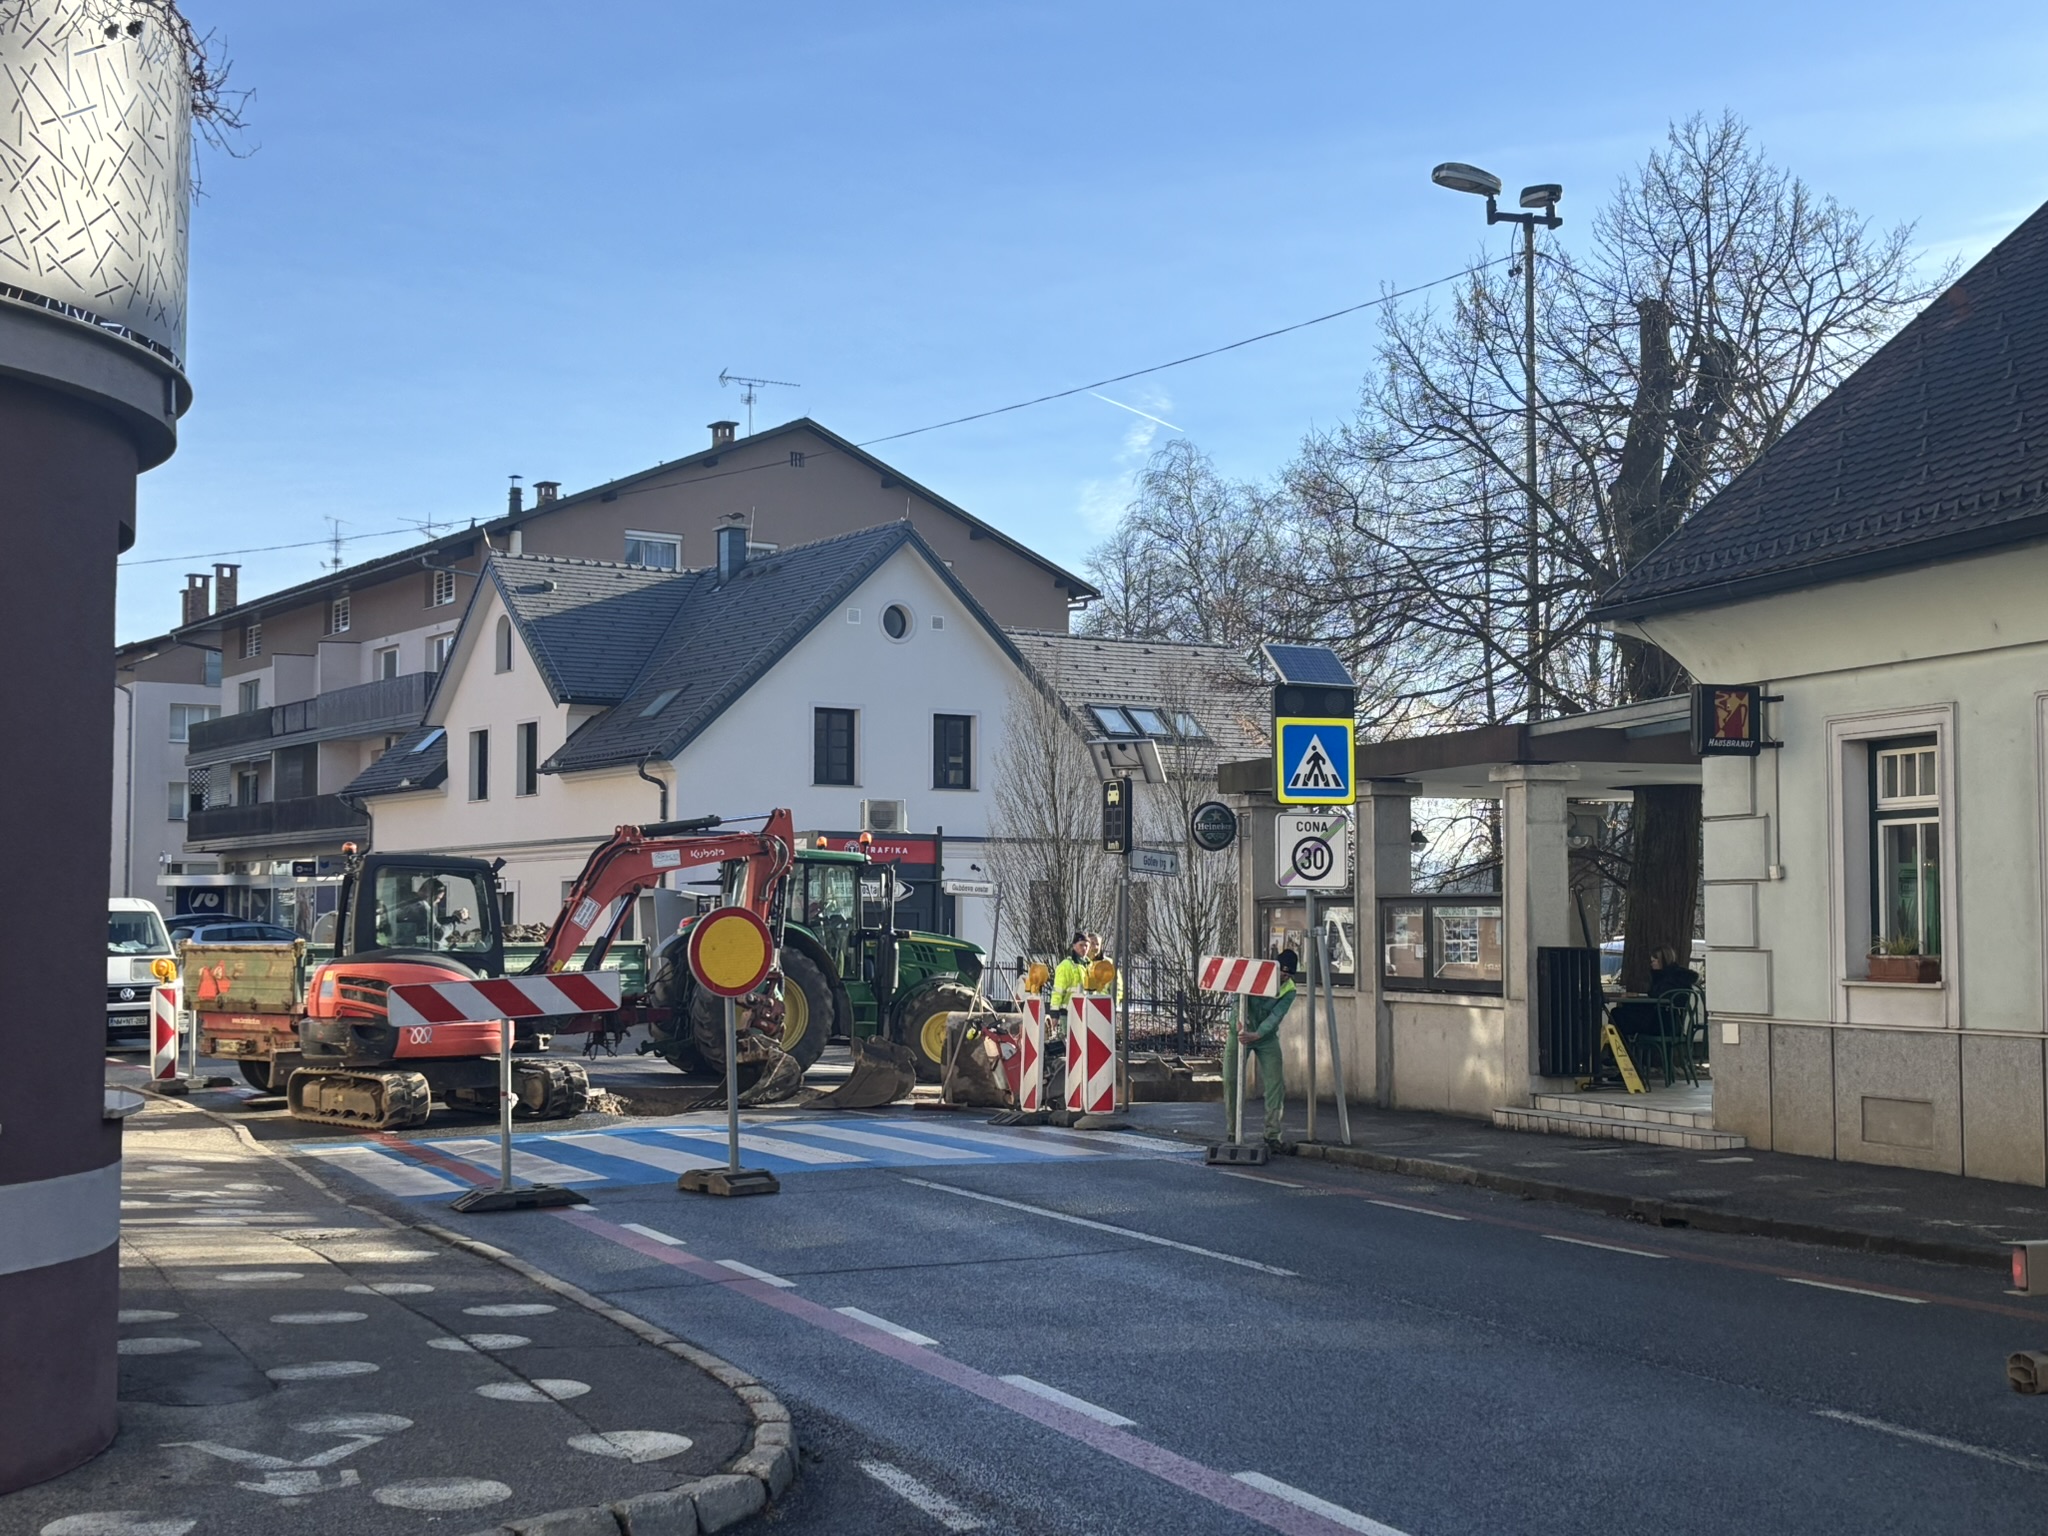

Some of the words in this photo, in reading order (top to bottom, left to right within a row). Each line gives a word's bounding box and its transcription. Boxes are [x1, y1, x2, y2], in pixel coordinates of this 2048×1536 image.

[1708, 738, 1755, 748] HAUSBRANDT
[1197, 823, 1232, 831] Heineken
[1297, 821, 1328, 832] CONA
[690, 848, 725, 859] Kubota
[1300, 847, 1324, 870] 30
